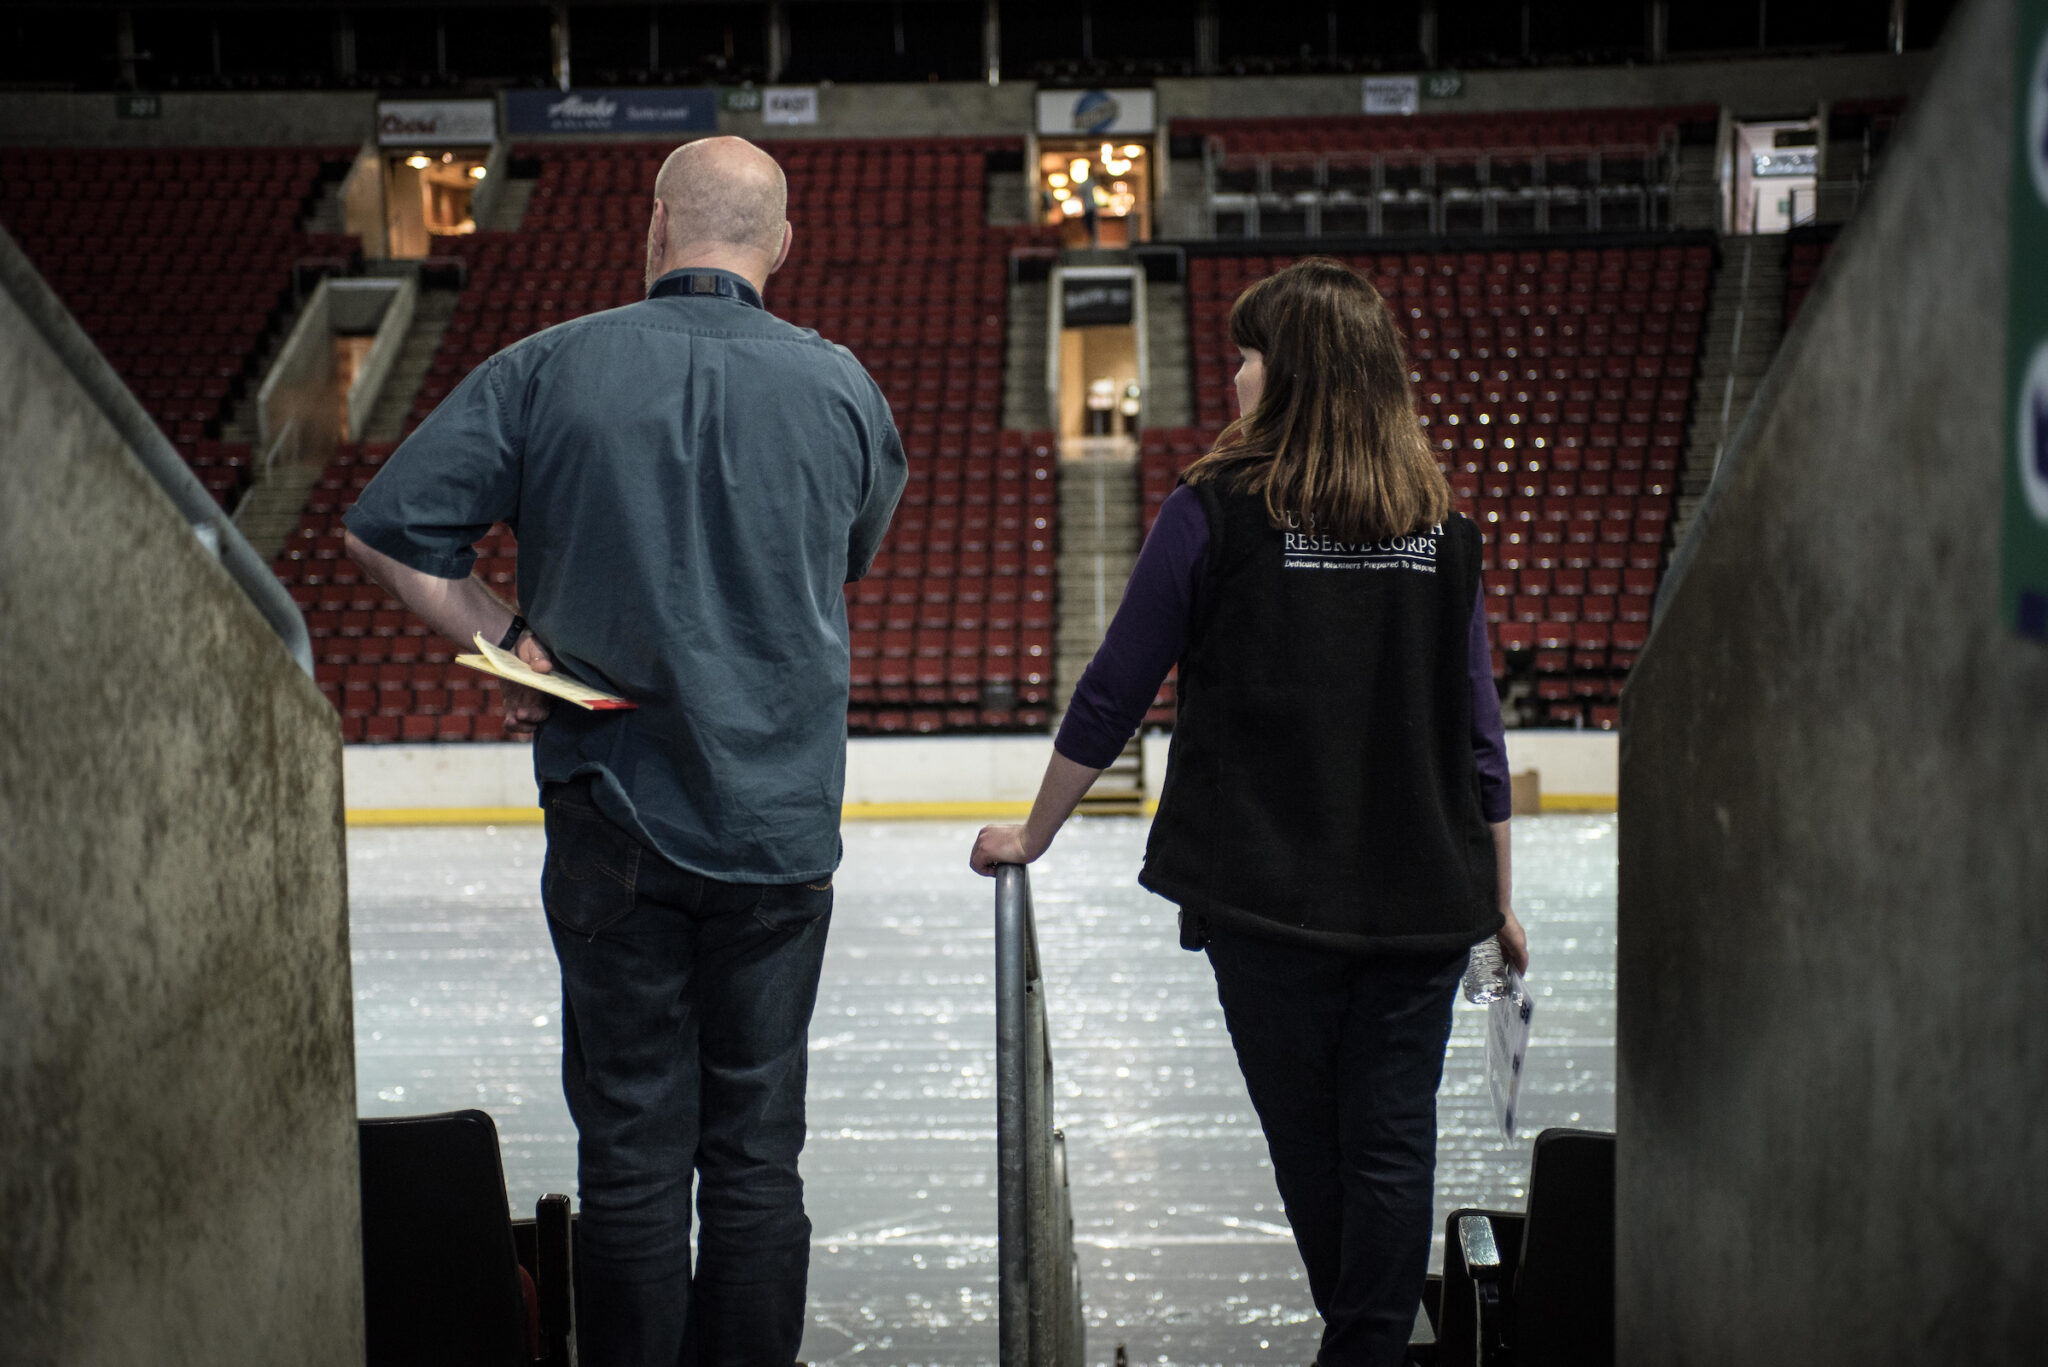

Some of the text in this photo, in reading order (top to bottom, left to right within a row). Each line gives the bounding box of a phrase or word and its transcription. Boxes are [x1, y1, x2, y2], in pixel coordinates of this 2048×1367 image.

[1378, 535, 1437, 556] CORPS
[1284, 558, 1437, 573] Dedicated Volunteers Prepared To Respond
